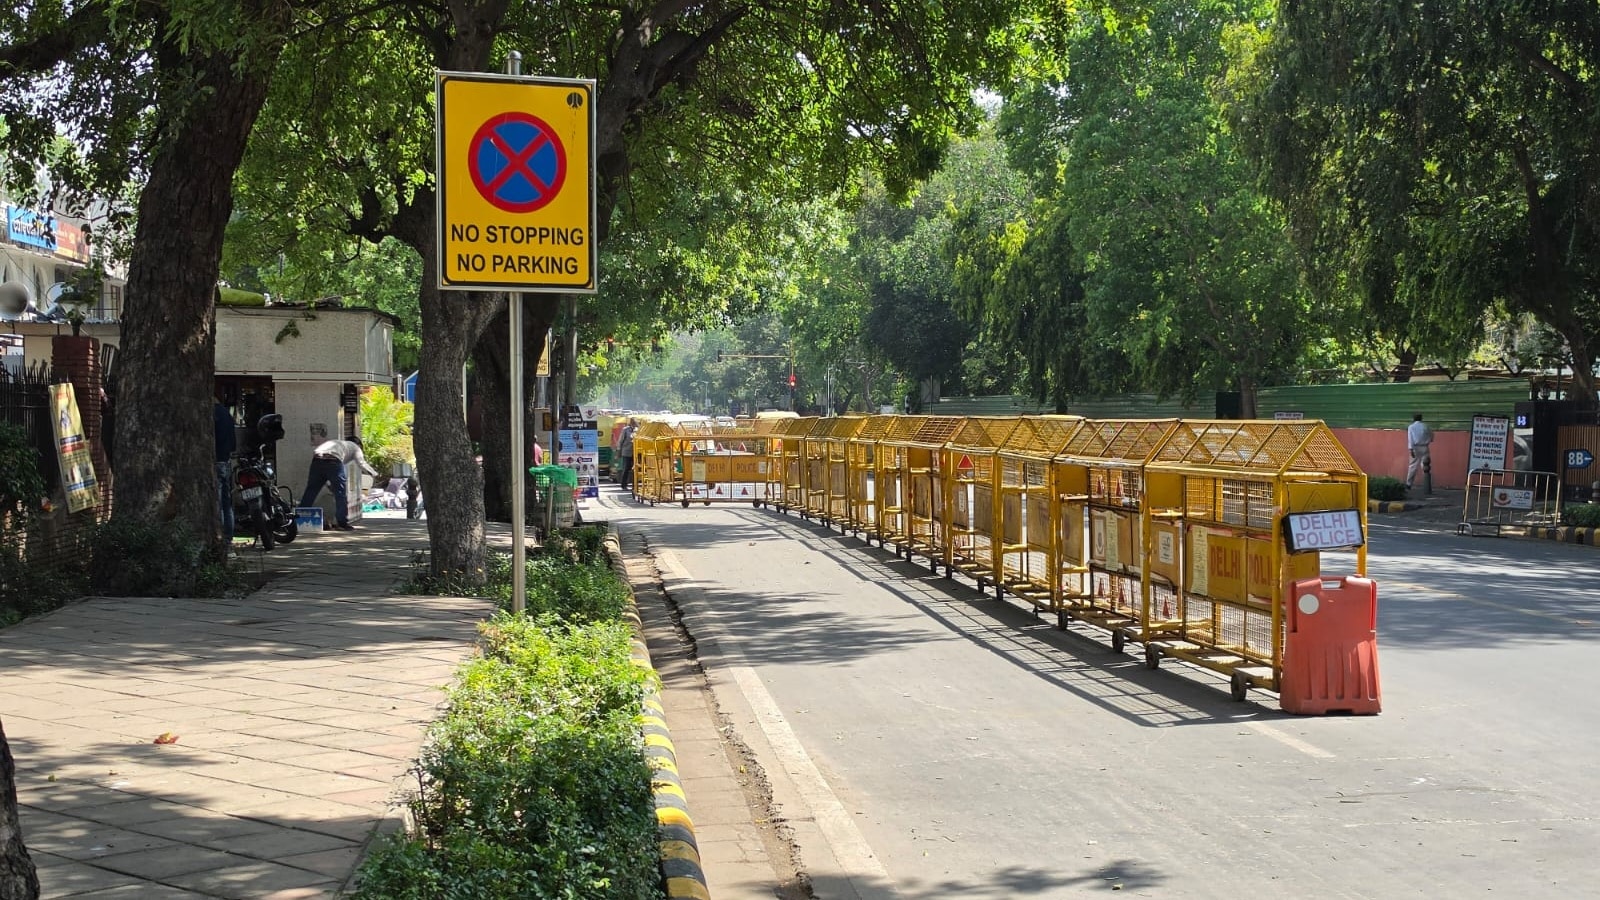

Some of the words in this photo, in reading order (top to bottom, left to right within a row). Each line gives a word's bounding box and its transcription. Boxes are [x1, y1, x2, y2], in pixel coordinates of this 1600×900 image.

[451, 224, 480, 243] NO
[486, 225, 584, 246] STOPPING
[457, 253, 486, 272] NO
[492, 254, 578, 275] PARKING
[736, 462, 757, 473] POLICE
[1568, 452, 1584, 465] 8B
[1300, 513, 1348, 531] DELHI
[1210, 545, 1241, 580] DELHI
[1248, 553, 1273, 586] POLI
